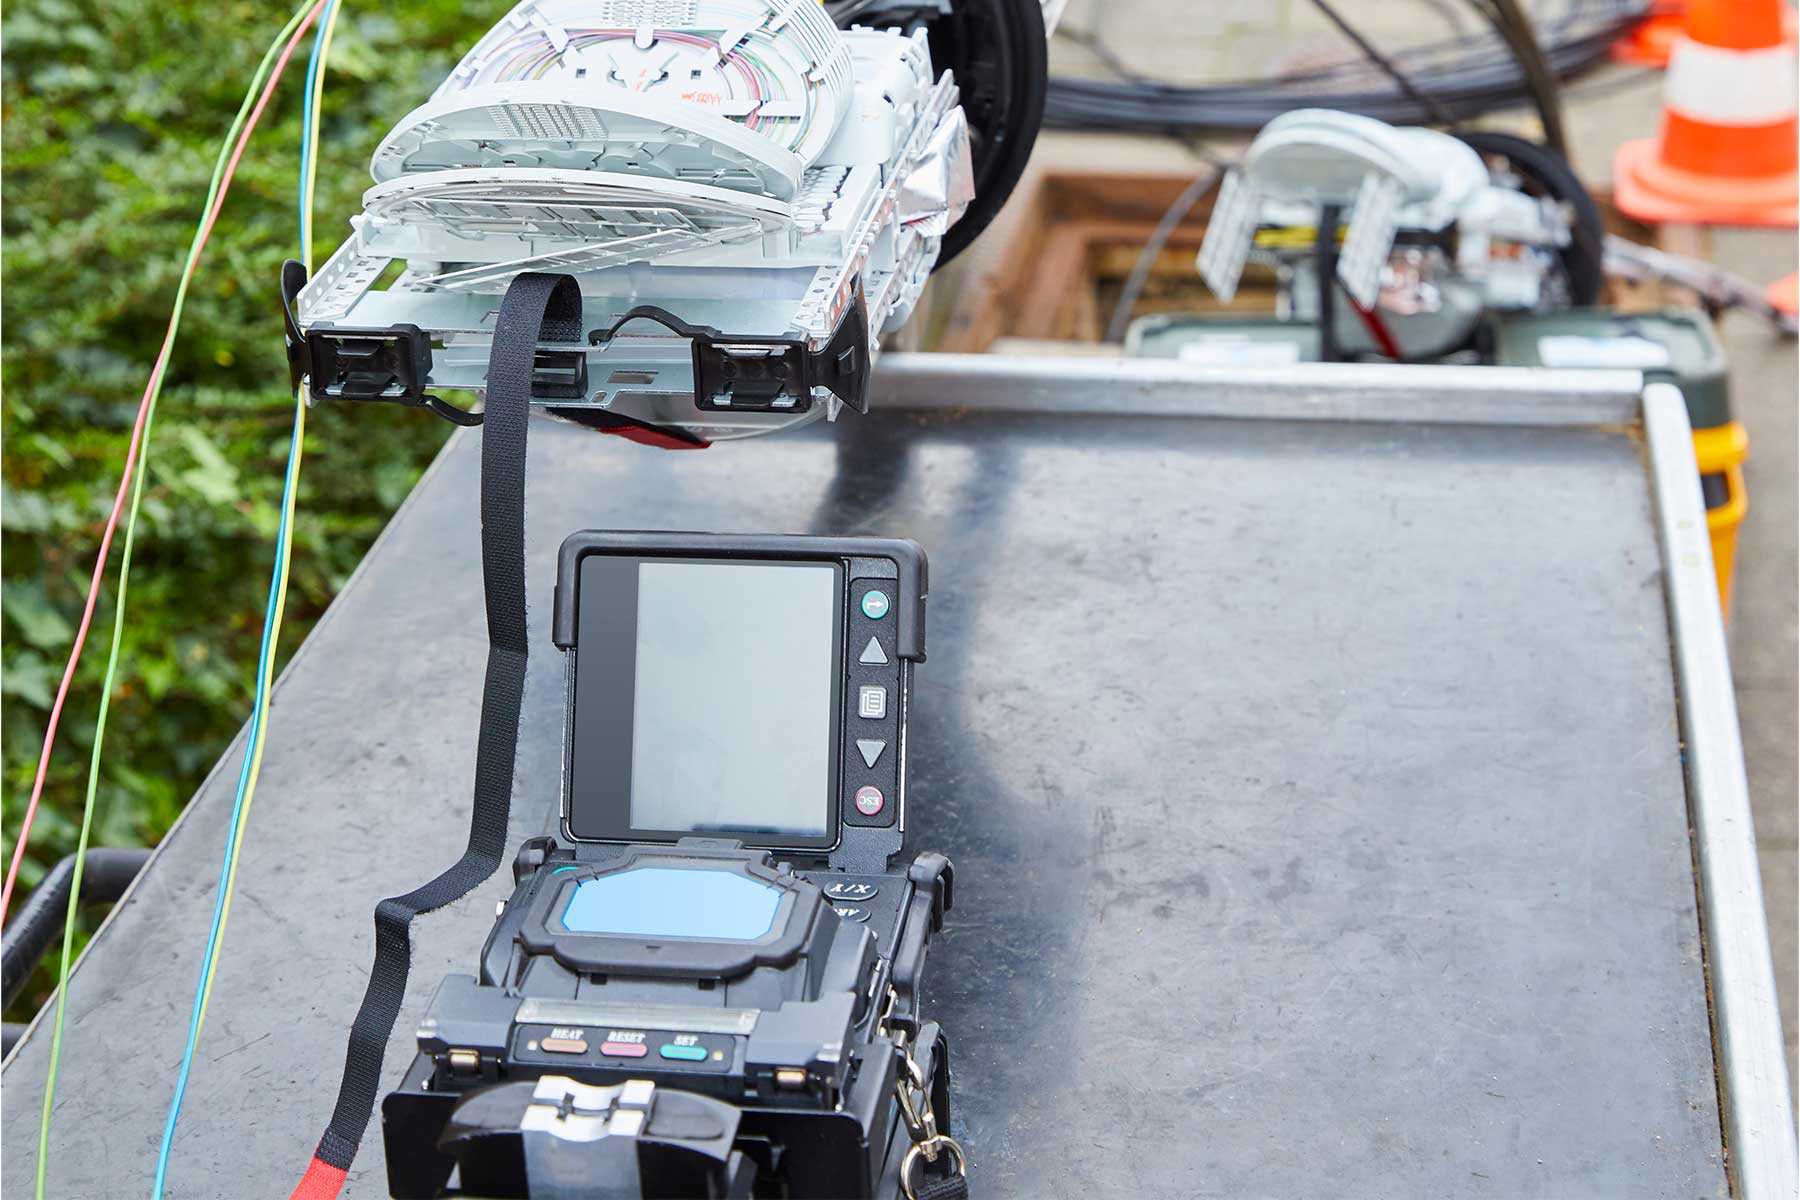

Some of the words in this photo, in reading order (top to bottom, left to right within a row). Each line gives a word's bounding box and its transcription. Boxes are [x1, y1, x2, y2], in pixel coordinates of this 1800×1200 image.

[859, 795, 880, 806] ESC
[830, 883, 872, 894] X/Y
[551, 1028, 584, 1040] HEAT
[607, 1030, 647, 1044] RESET
[673, 1035, 699, 1046] SET
